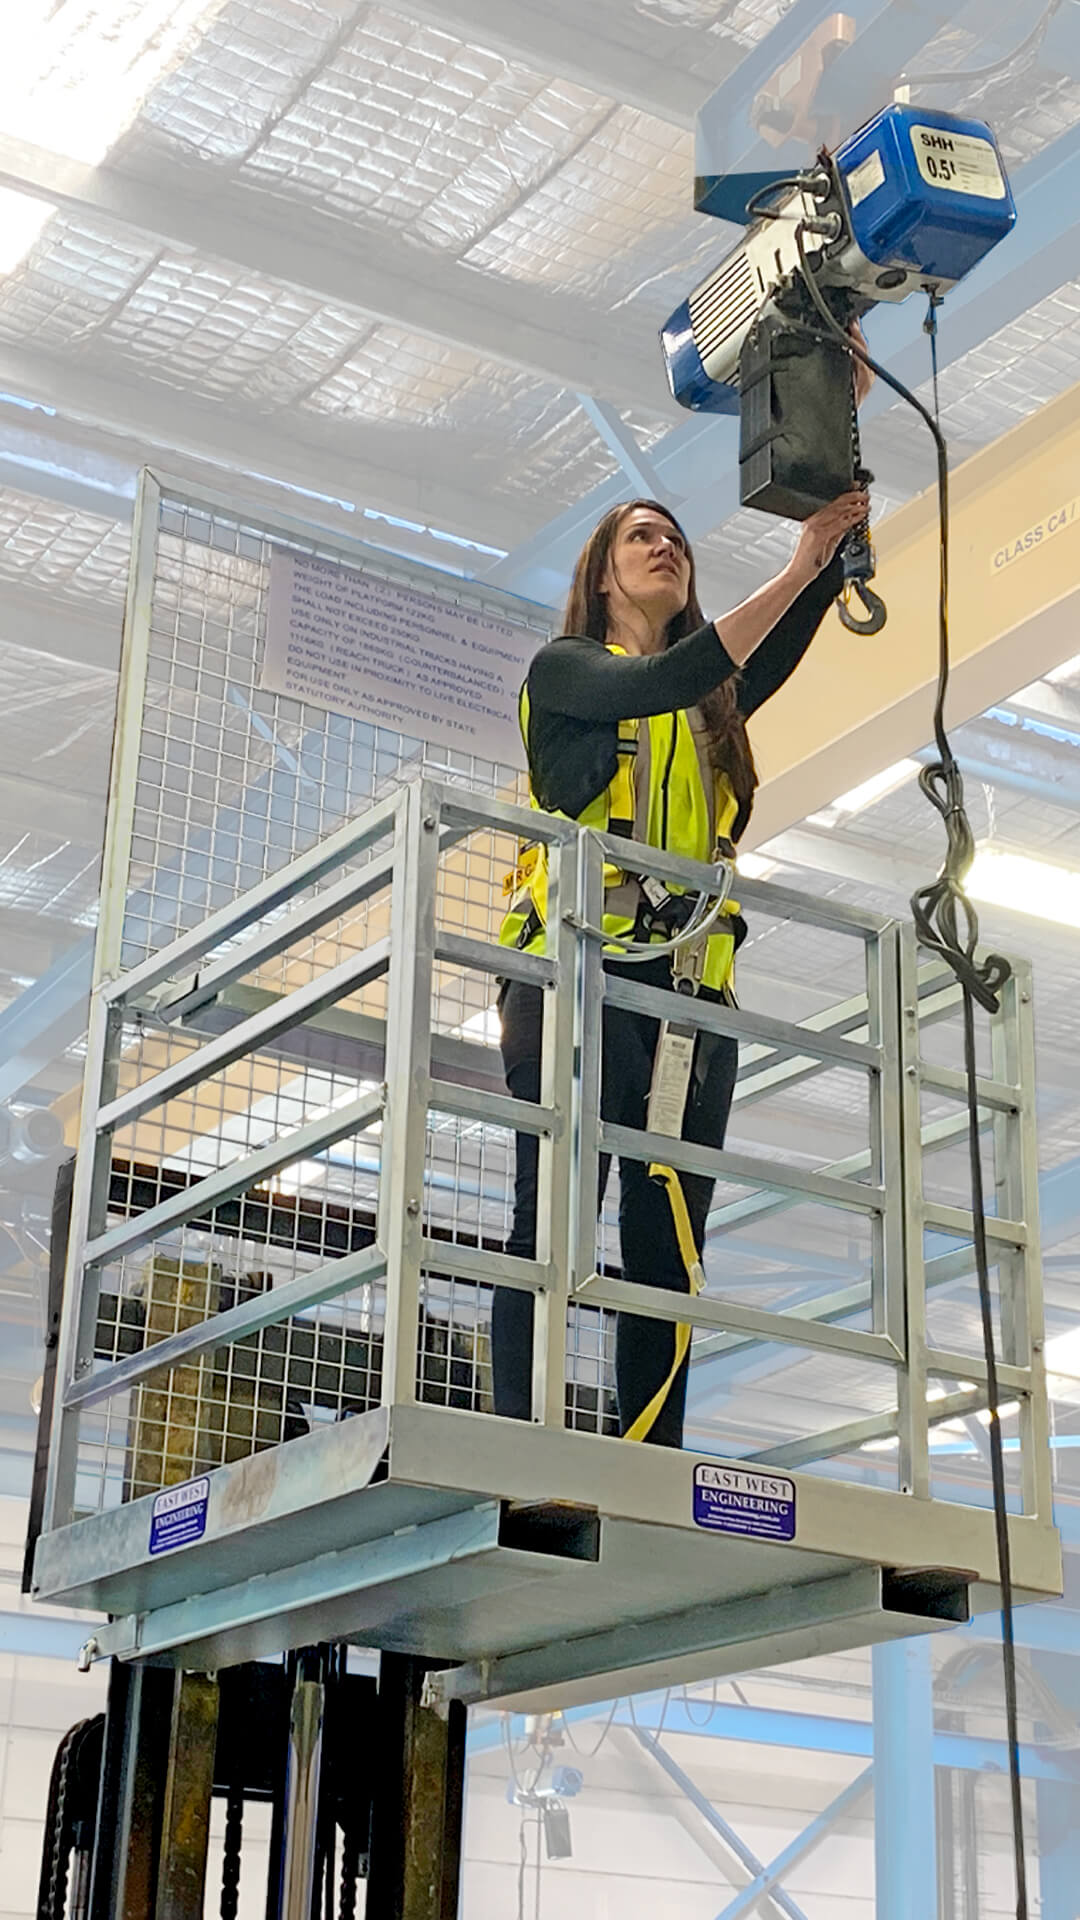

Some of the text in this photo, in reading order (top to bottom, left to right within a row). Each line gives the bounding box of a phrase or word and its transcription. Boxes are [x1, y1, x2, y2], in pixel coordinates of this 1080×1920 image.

[920, 133, 955, 151] SHH
[994, 525, 1043, 568] CLASS
[1047, 508, 1067, 533] C4
[294, 571, 332, 588] WEIGHT
[335, 584, 348, 592] OF
[351, 589, 403, 611] PLATFORM
[294, 558, 309, 568] NO
[311, 563, 340, 578] MORE
[343, 574, 369, 588] THAN
[397, 592, 442, 613] PERSONS
[445, 608, 464, 619] MAY
[466, 616, 478, 626] BE
[482, 621, 513, 637] LIFTED
[292, 595, 322, 611] SHALL
[325, 606, 345, 617] NOT
[348, 613, 388, 632] EXCEED
[294, 582, 312, 594] THE
[315, 590, 341, 603] LOAD
[343, 599, 397, 622] INCLUDING
[400, 617, 456, 642] PERSONNEL
[472, 641, 525, 664] EQUIPMENT
[289, 620, 339, 640] CAPACITY
[342, 636, 355, 645] OF
[291, 607, 504, 683] USE ONLY ON INDUSTRIAL TRUCKS HAVING A
[287, 656, 346, 680] EQUIPMENT
[288, 643, 513, 722] DO NOT USE IN PROXIMITY TO LIVE ELECTRICAL
[416, 673, 428, 682] AS
[431, 677, 482, 700] APPROVED
[285, 681, 404, 724] STATUTORY AUTHORITY
[286, 668, 476, 735] FOR USE ONLY AS APPROVED BY STATE
[156, 1482, 205, 1512] EAST WEST
[701, 1468, 789, 1497] EAST WEST
[155, 1502, 204, 1530] ENGINEERING
[702, 1489, 788, 1515] ENGINEERING
